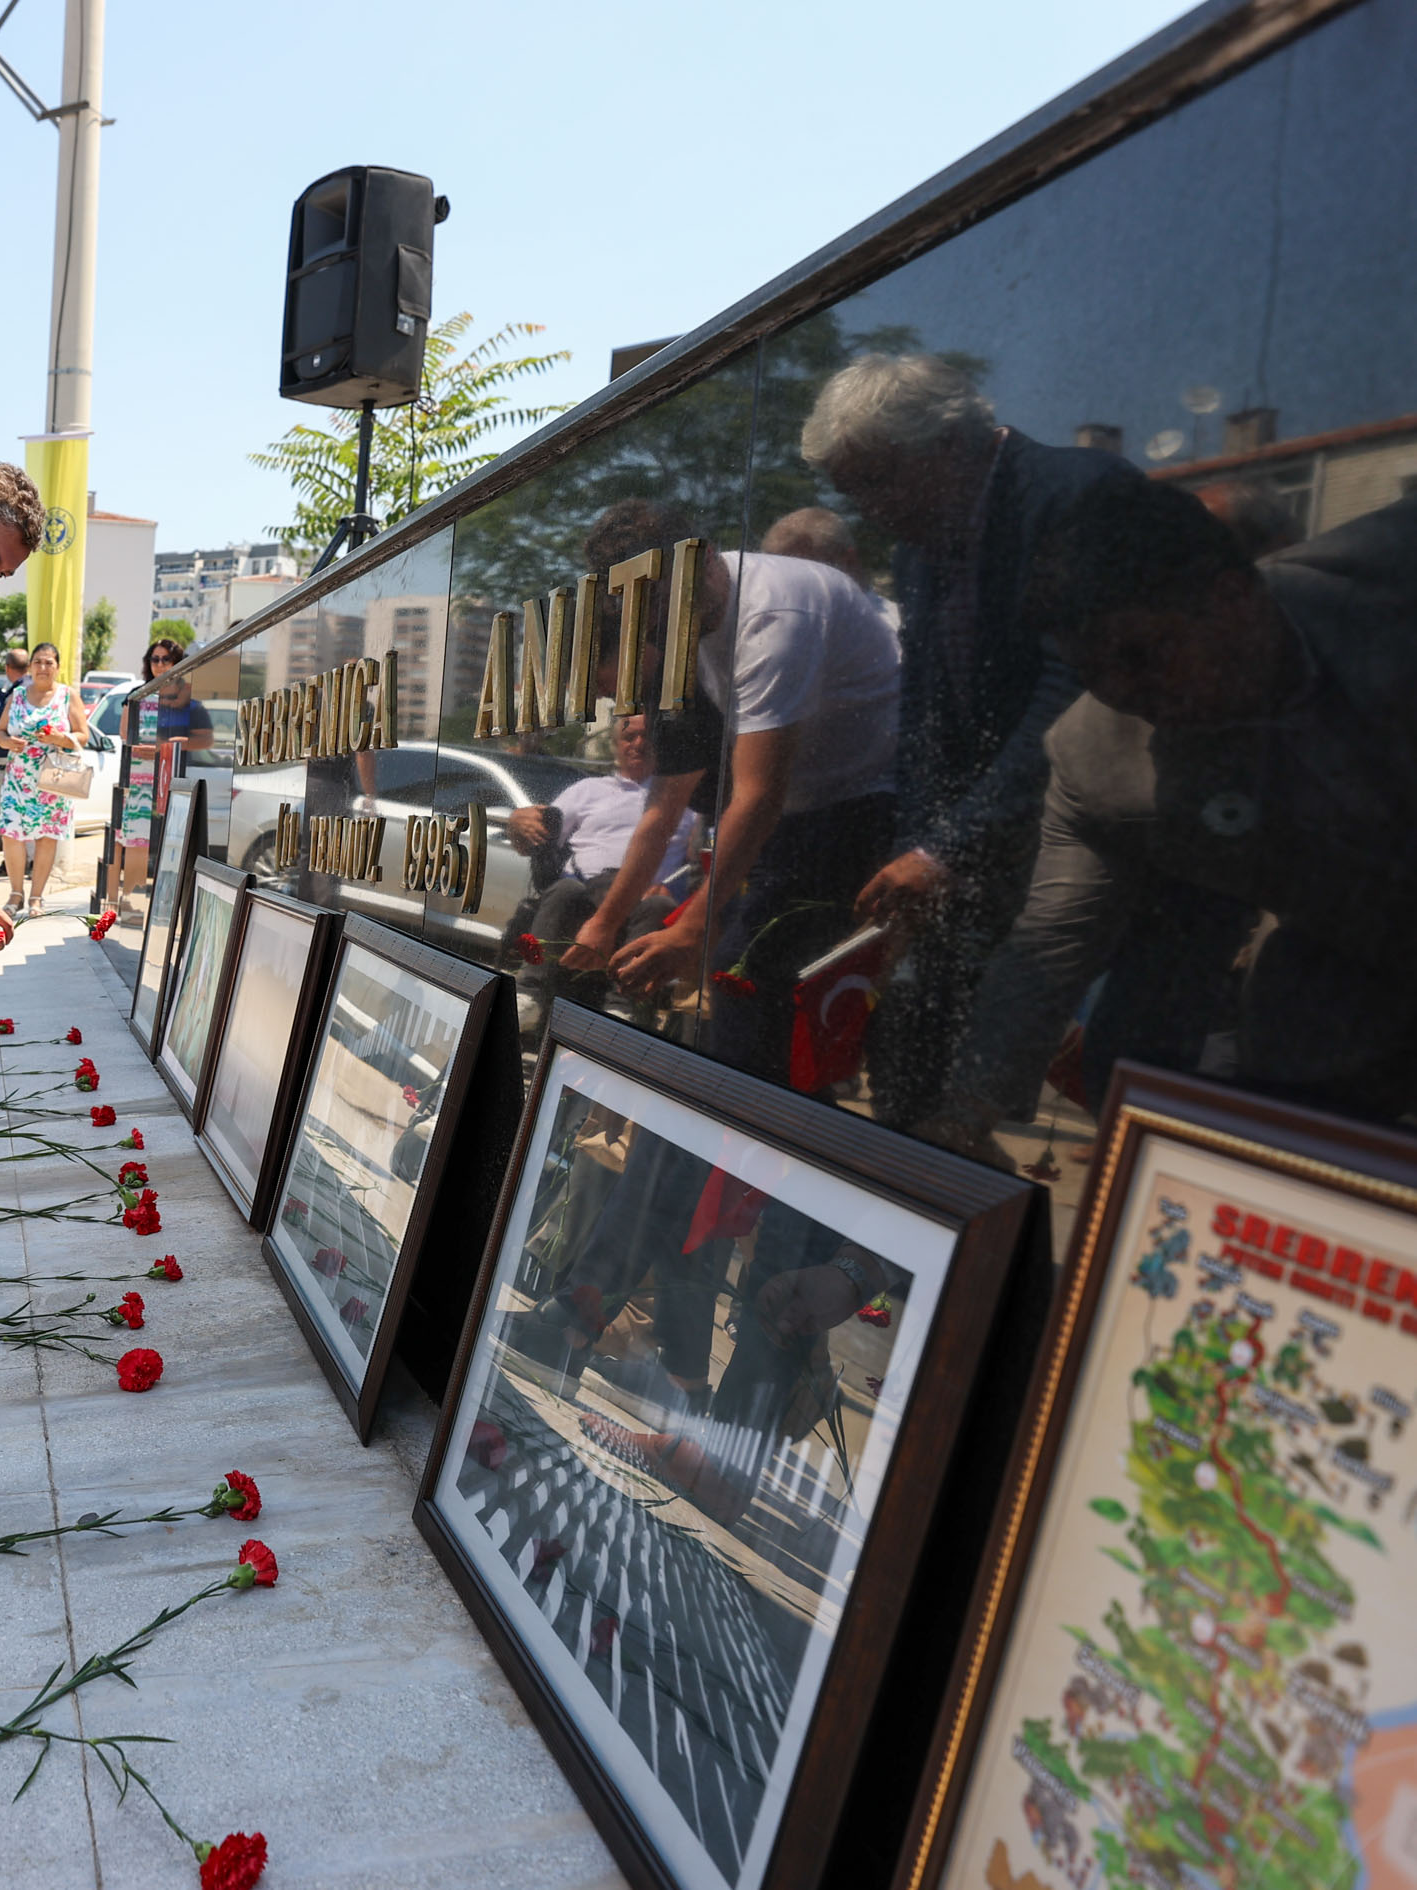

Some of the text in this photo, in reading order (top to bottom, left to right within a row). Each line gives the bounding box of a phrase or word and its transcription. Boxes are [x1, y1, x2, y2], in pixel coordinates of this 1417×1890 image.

[236, 538, 700, 767] SREBRENICA ANITI
[308, 815, 386, 882] TEMMUZ
